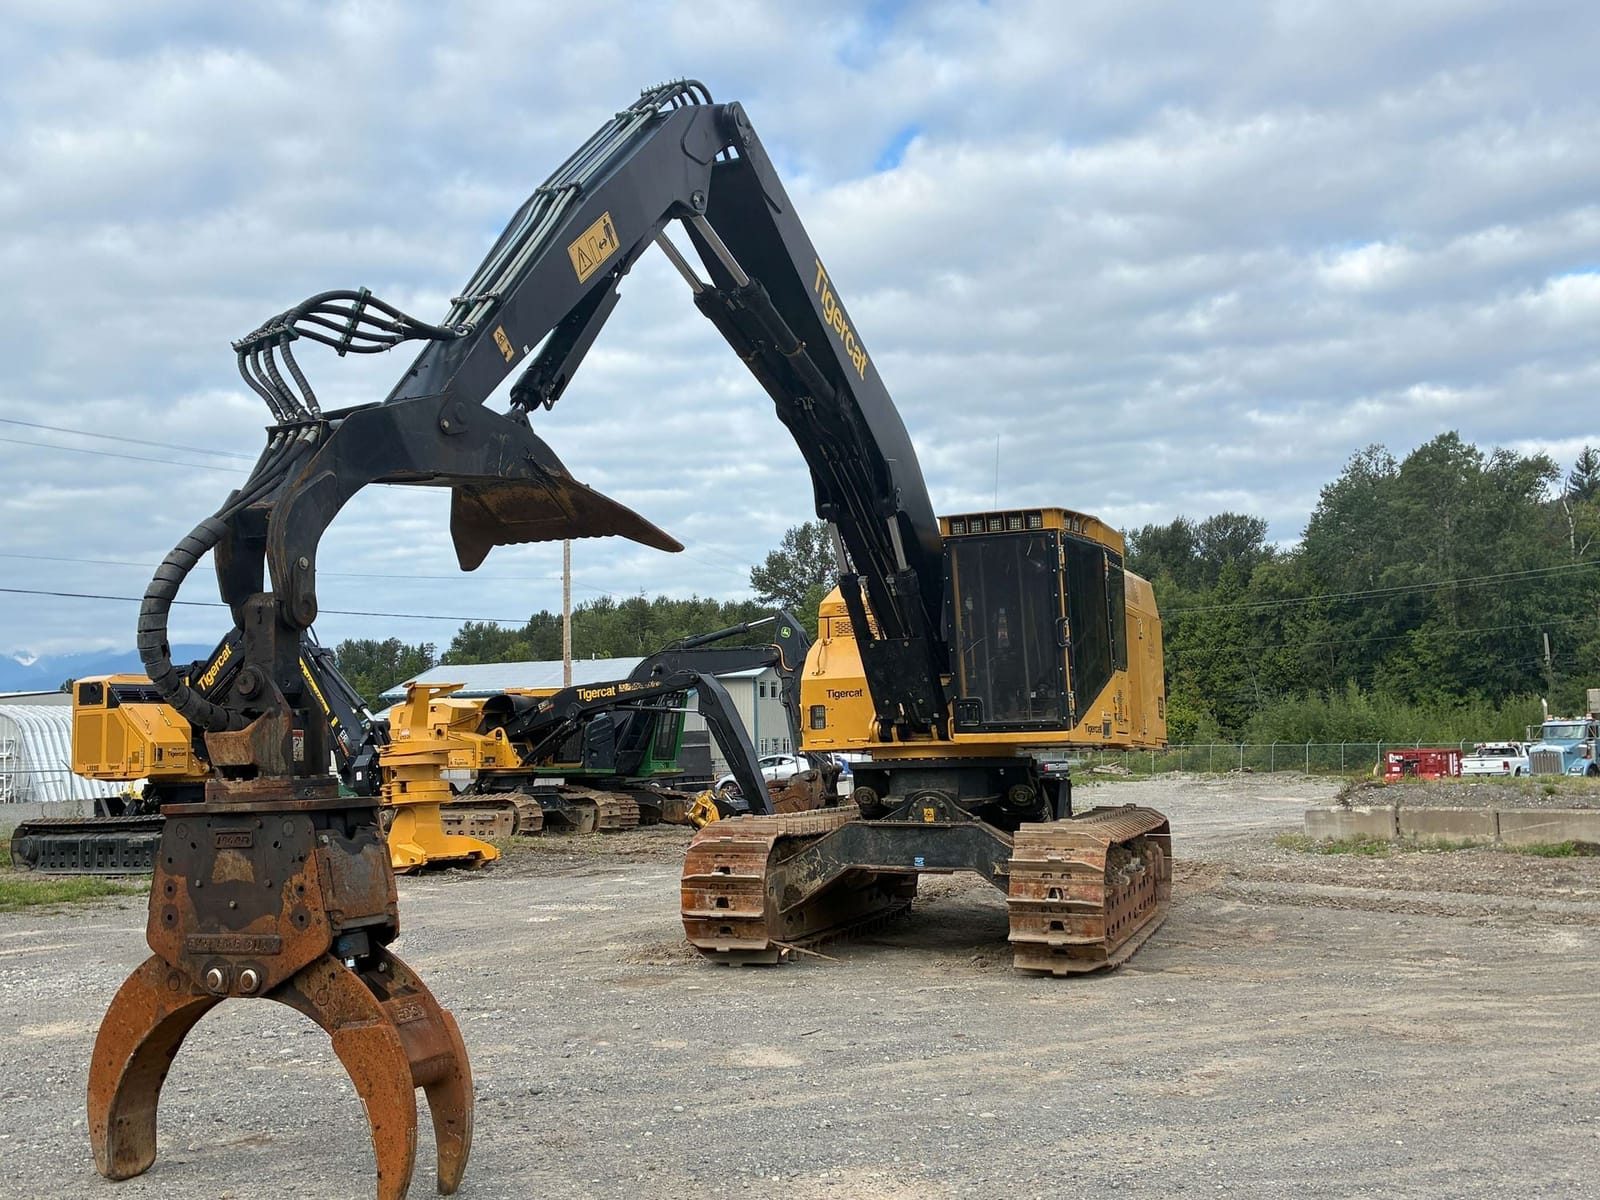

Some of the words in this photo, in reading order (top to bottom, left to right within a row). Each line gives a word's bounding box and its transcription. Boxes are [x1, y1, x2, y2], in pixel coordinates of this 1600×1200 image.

[815, 258, 868, 381] Tigercat
[197, 641, 232, 691] Tigercat
[576, 685, 616, 702] Tigercat
[825, 688, 863, 701] Tigercat
